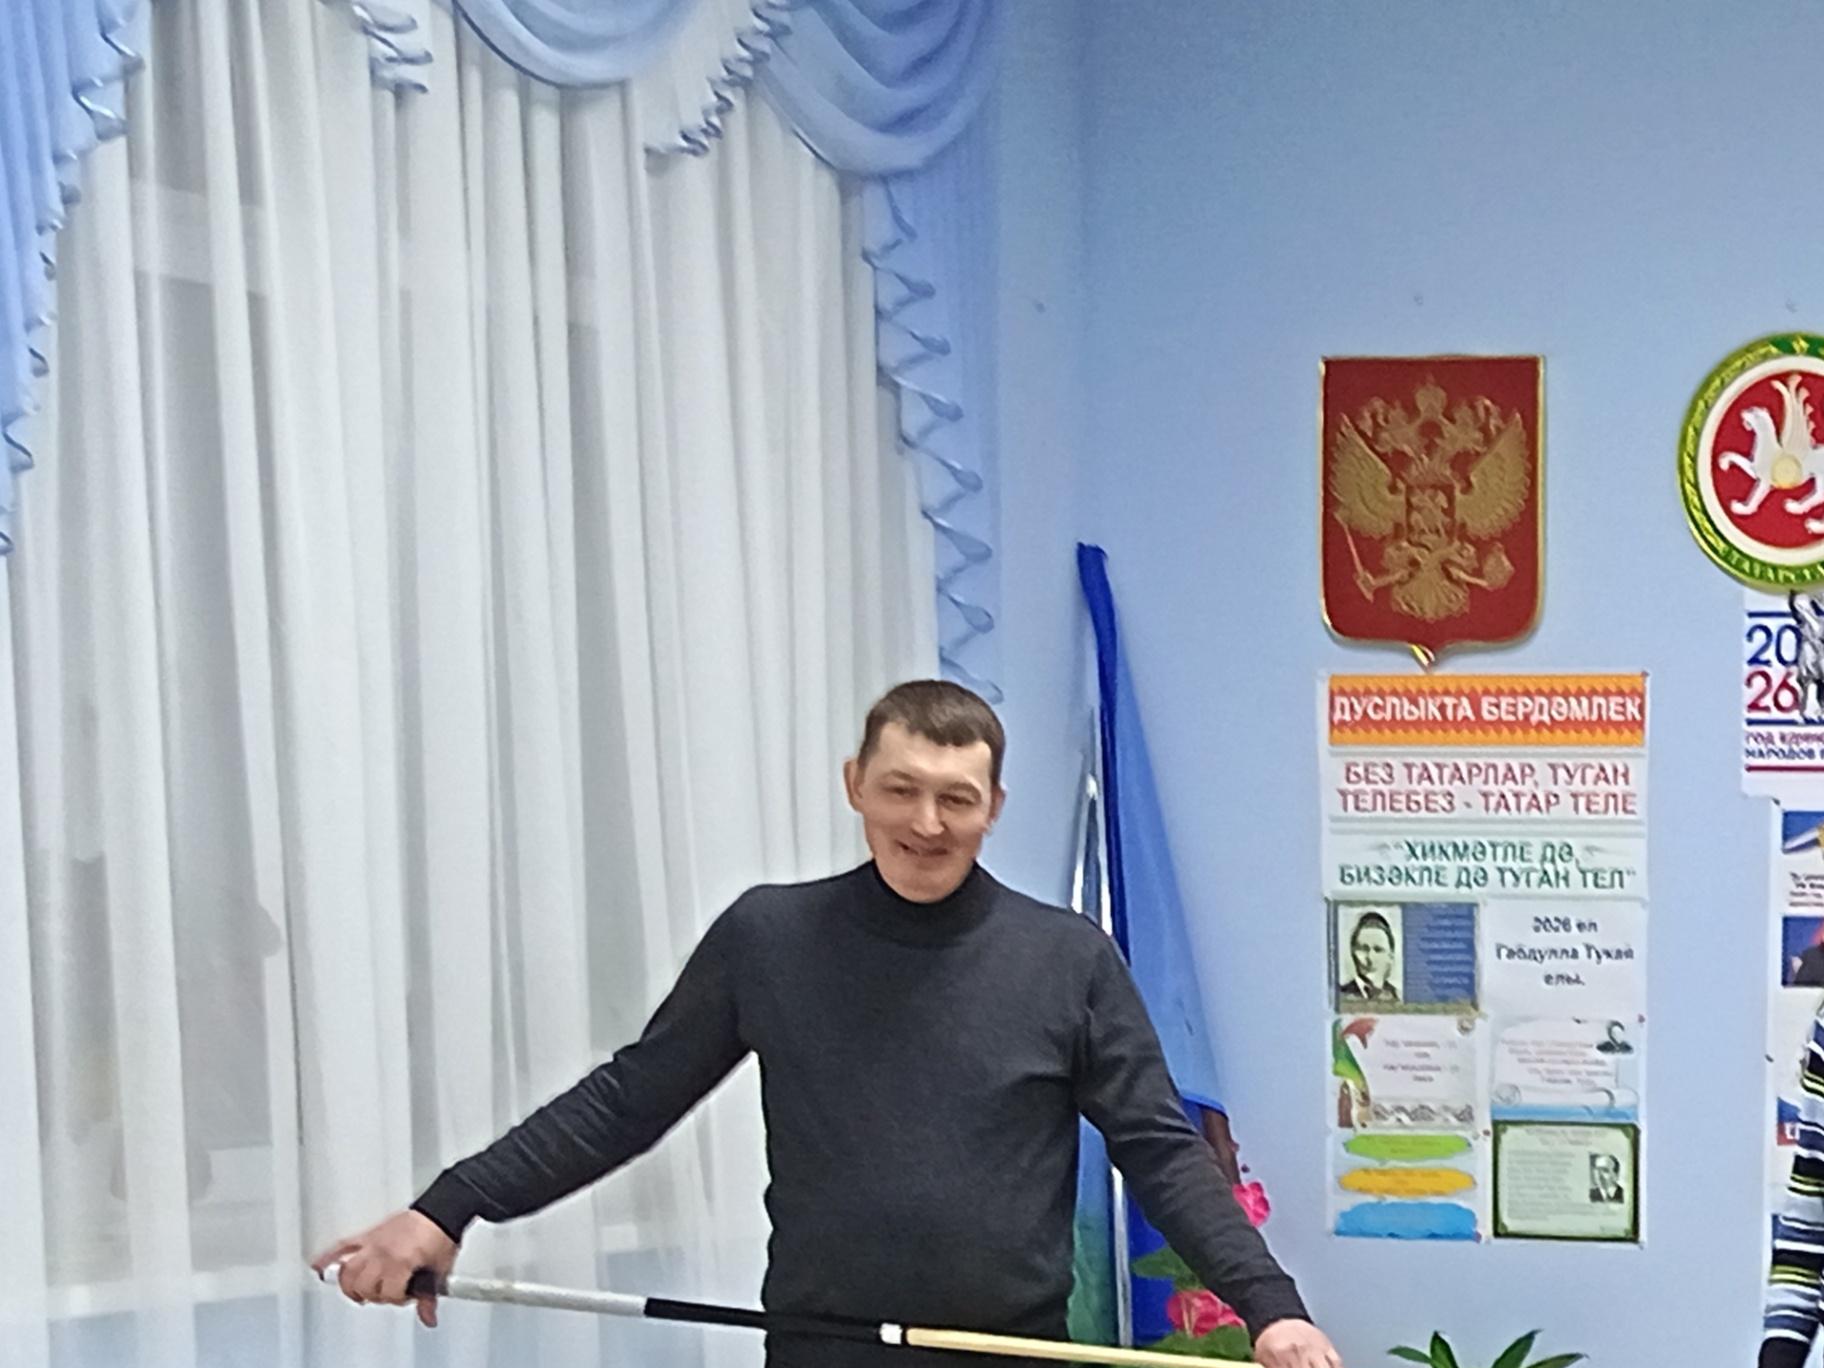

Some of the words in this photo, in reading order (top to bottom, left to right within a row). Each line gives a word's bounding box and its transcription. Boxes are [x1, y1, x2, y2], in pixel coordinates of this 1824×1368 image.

[1746, 623, 1803, 667] 20
[1745, 669, 1801, 713] 26
[1333, 695, 1474, 725] ДУСЛЫКТА
[1481, 695, 1641, 726] БЕРДӘМЛЕК
[1345, 762, 1395, 785] БЕЗ
[1402, 762, 1539, 789] ТАТАРЛАР,
[1547, 762, 1630, 786] ТУГАН
[1337, 788, 1456, 814] ТЕЛЕБЕЗ
[1479, 789, 1560, 815] ТАТАР
[1570, 790, 1638, 815] ТЕЛЕ
[1339, 864, 1449, 887] БИЗӘКЛЕ
[1455, 864, 1489, 889] ДӘ
[1496, 865, 1570, 889] ТУГАН
